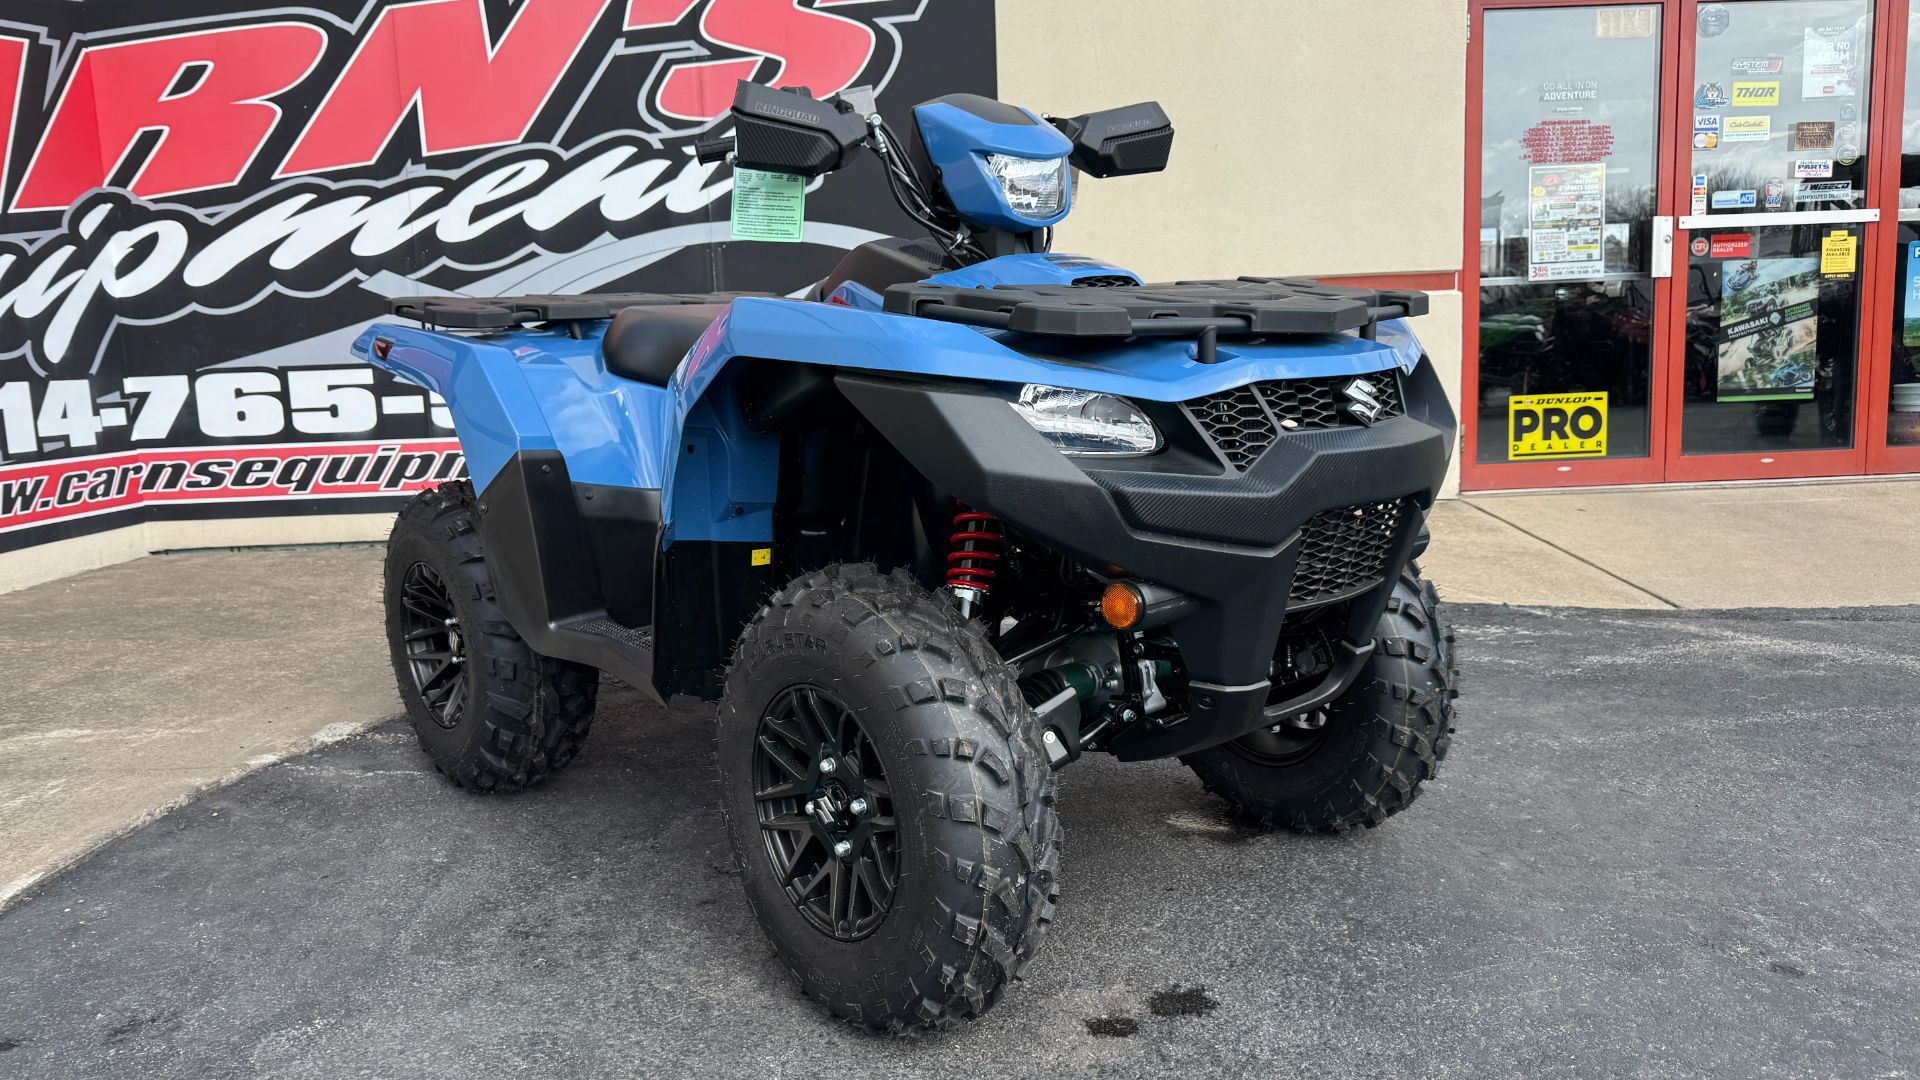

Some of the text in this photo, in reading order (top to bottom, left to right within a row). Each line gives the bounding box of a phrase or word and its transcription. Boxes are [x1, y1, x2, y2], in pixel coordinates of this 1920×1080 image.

[1556, 82, 1573, 90] ALL
[1543, 90, 1597, 101] ADVENTURE
[1736, 87, 1776, 98] THOR
[0, 0, 875, 213] RN'S
[755, 102, 820, 124] KINGQUAD
[1697, 117, 1718, 126] VISA
[1809, 182, 1850, 190] WISECO
[1740, 194, 1755, 203] ADT
[0, 129, 738, 363] ipment
[1531, 266, 1538, 278] 3
[1727, 316, 1769, 335] KAWASAKI
[1535, 396, 1592, 405] DUNLOP
[1513, 406, 1603, 442] PRO
[1512, 440, 1602, 452] DEALER
